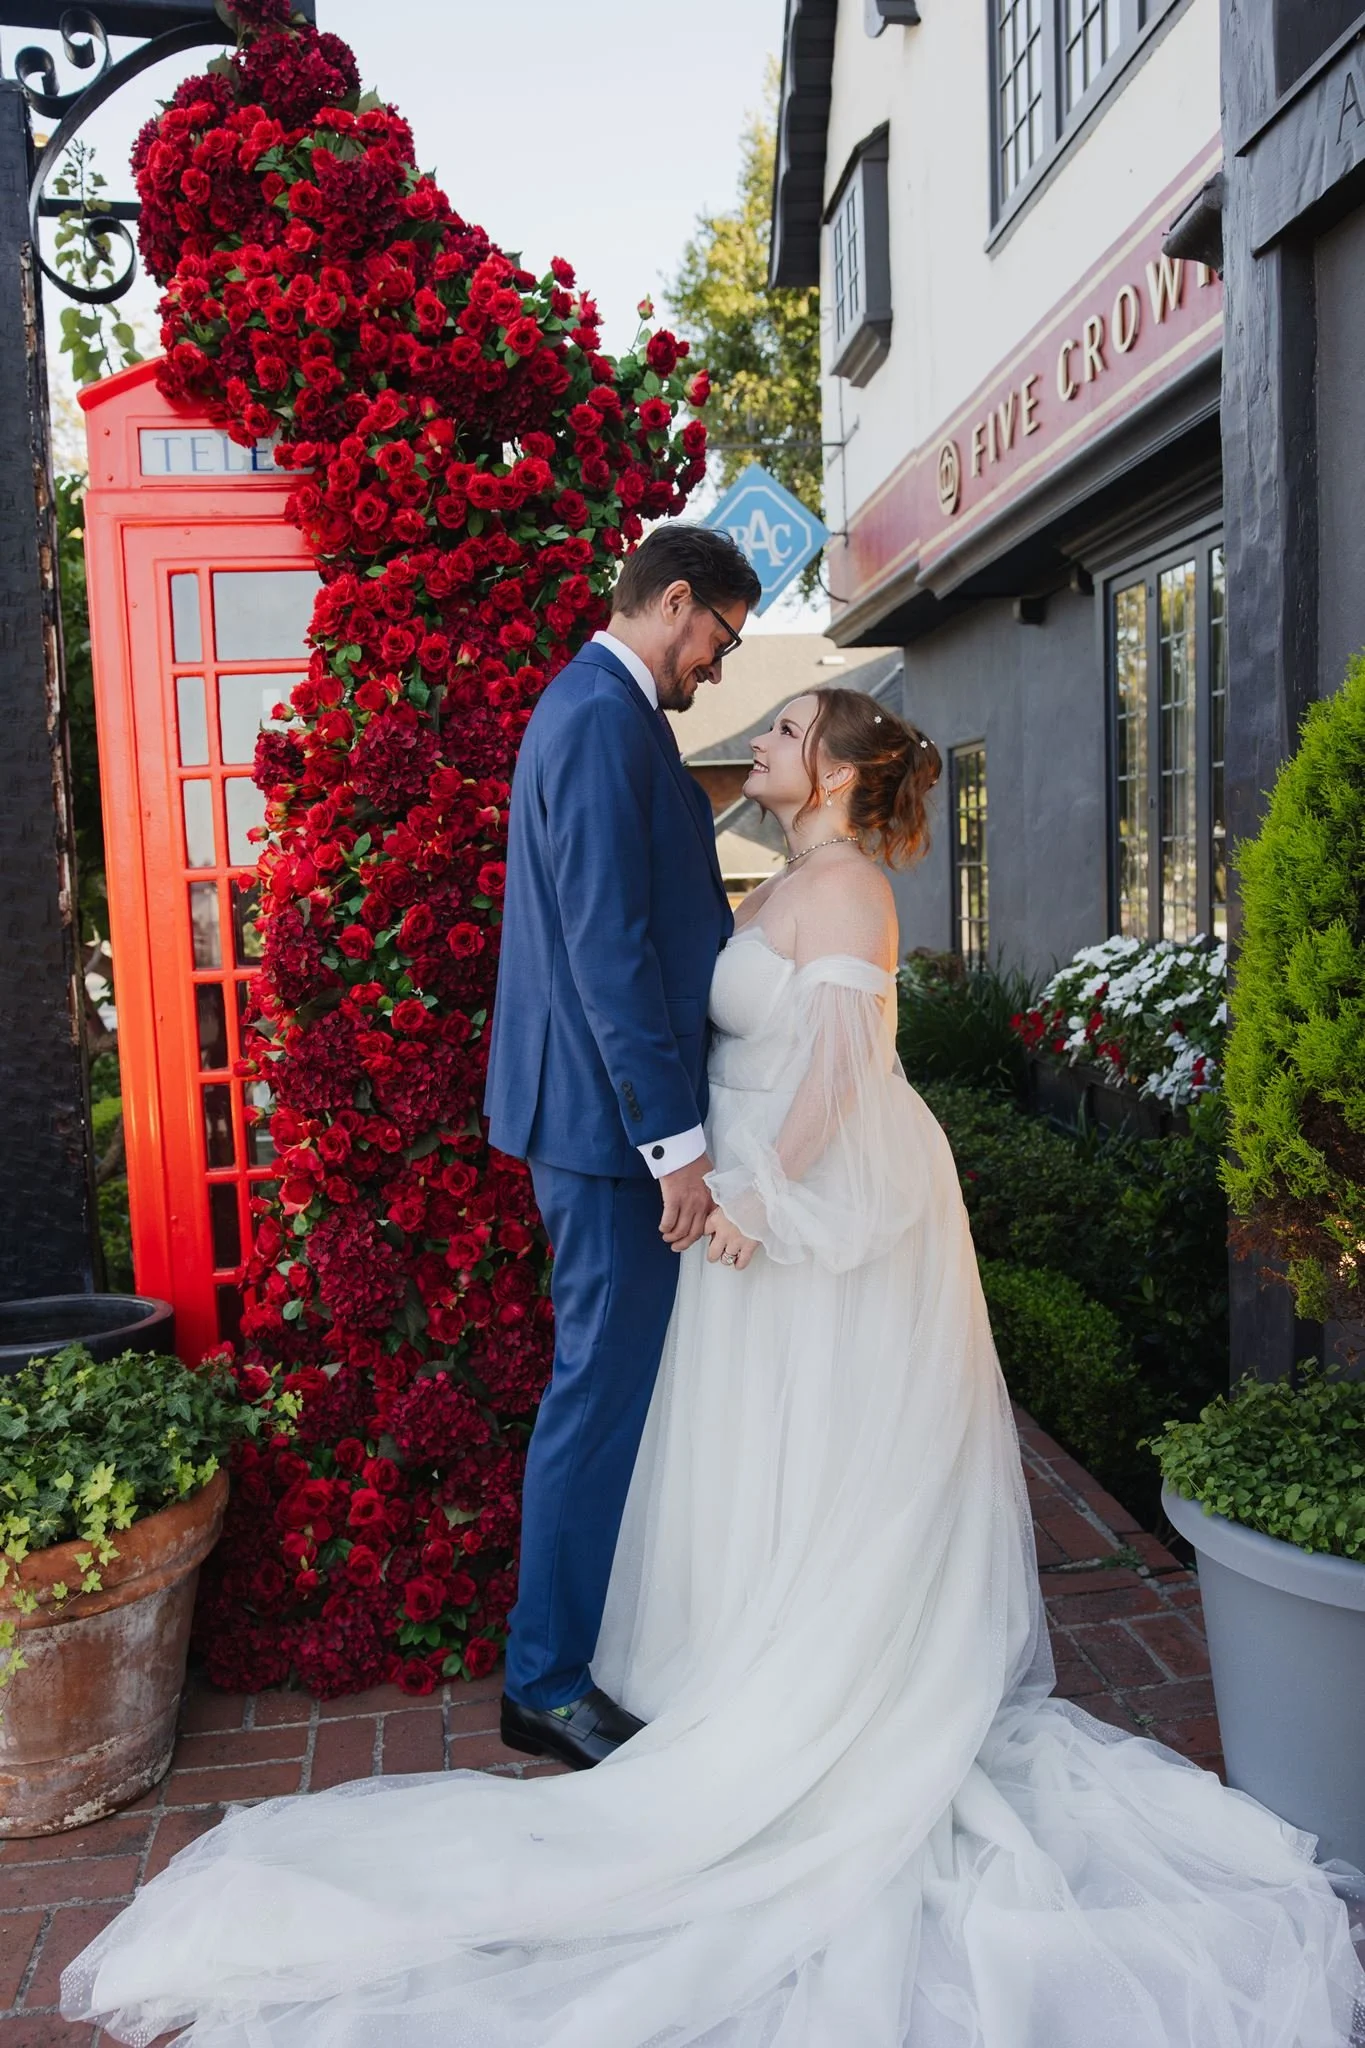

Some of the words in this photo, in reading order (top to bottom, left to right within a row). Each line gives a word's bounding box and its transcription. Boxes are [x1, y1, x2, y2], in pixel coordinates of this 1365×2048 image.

[971, 373, 1041, 478] FIVE
[1057, 254, 1213, 402] CROW
[728, 509, 792, 567] RAC
